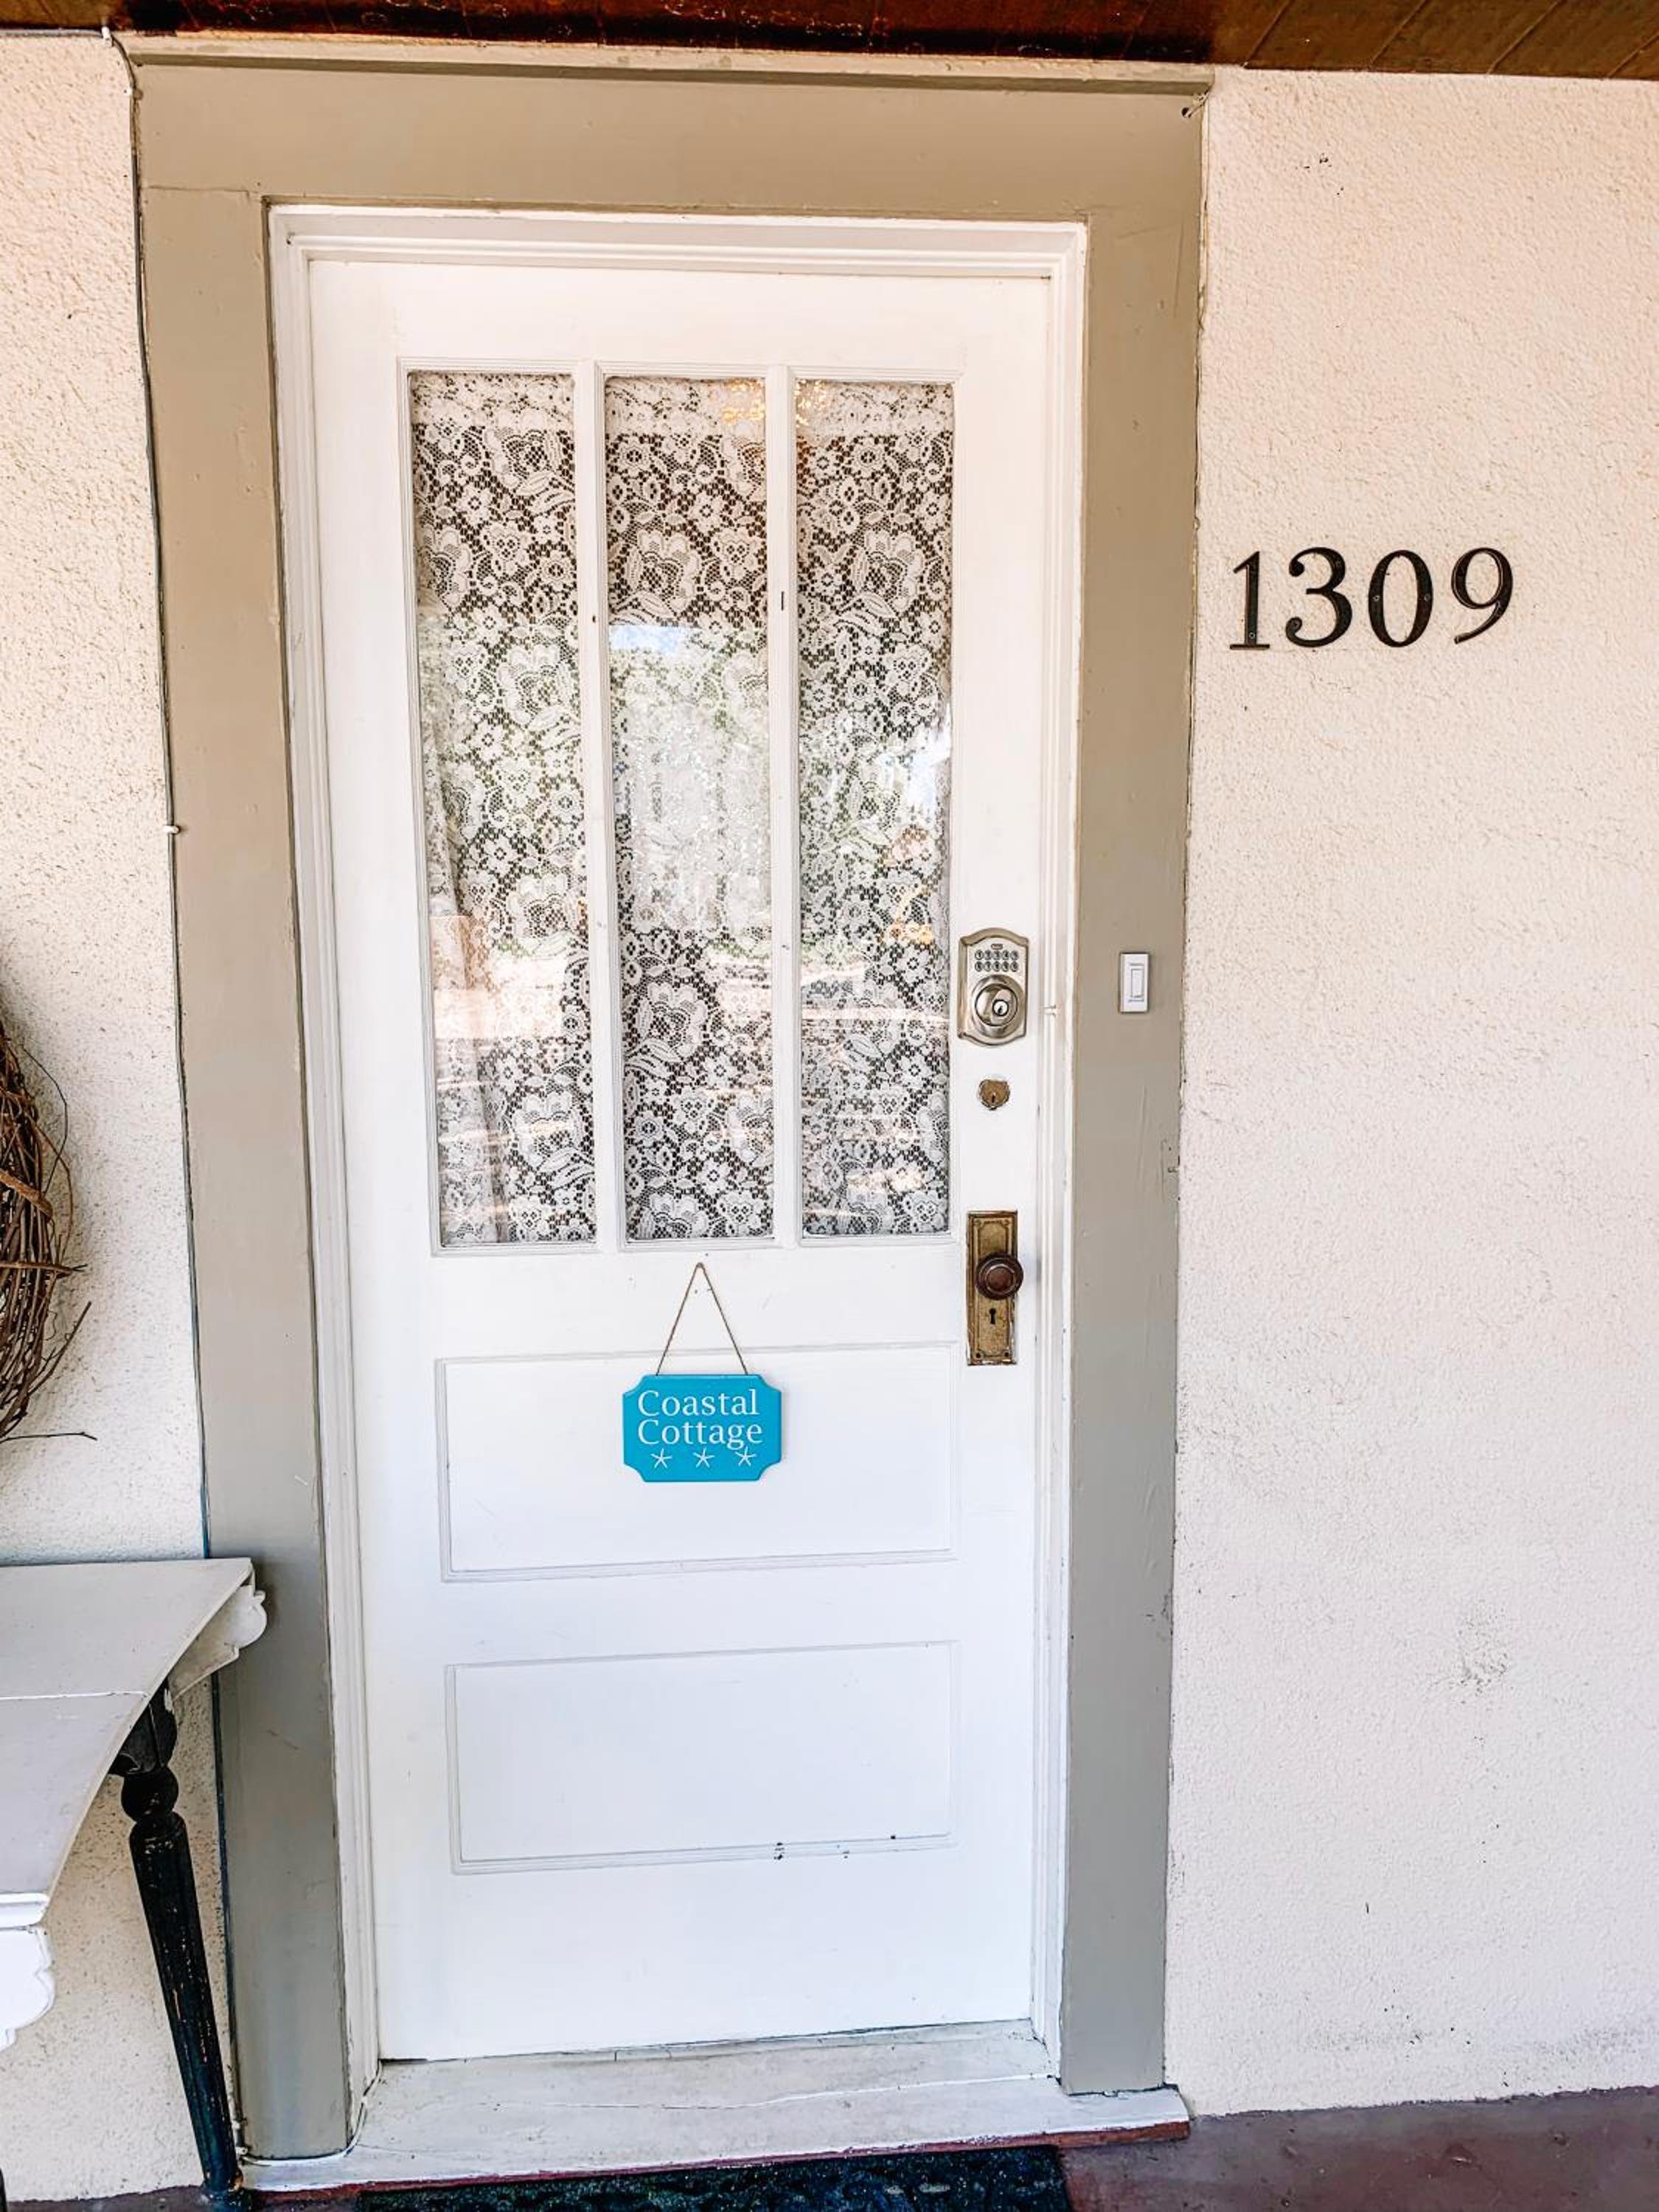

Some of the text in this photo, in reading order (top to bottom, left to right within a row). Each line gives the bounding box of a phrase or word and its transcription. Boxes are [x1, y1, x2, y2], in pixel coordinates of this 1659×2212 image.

[1229, 546, 1514, 650] 1309
[638, 1388, 760, 1416] Coastal
[638, 1419, 762, 1451] Cottage
